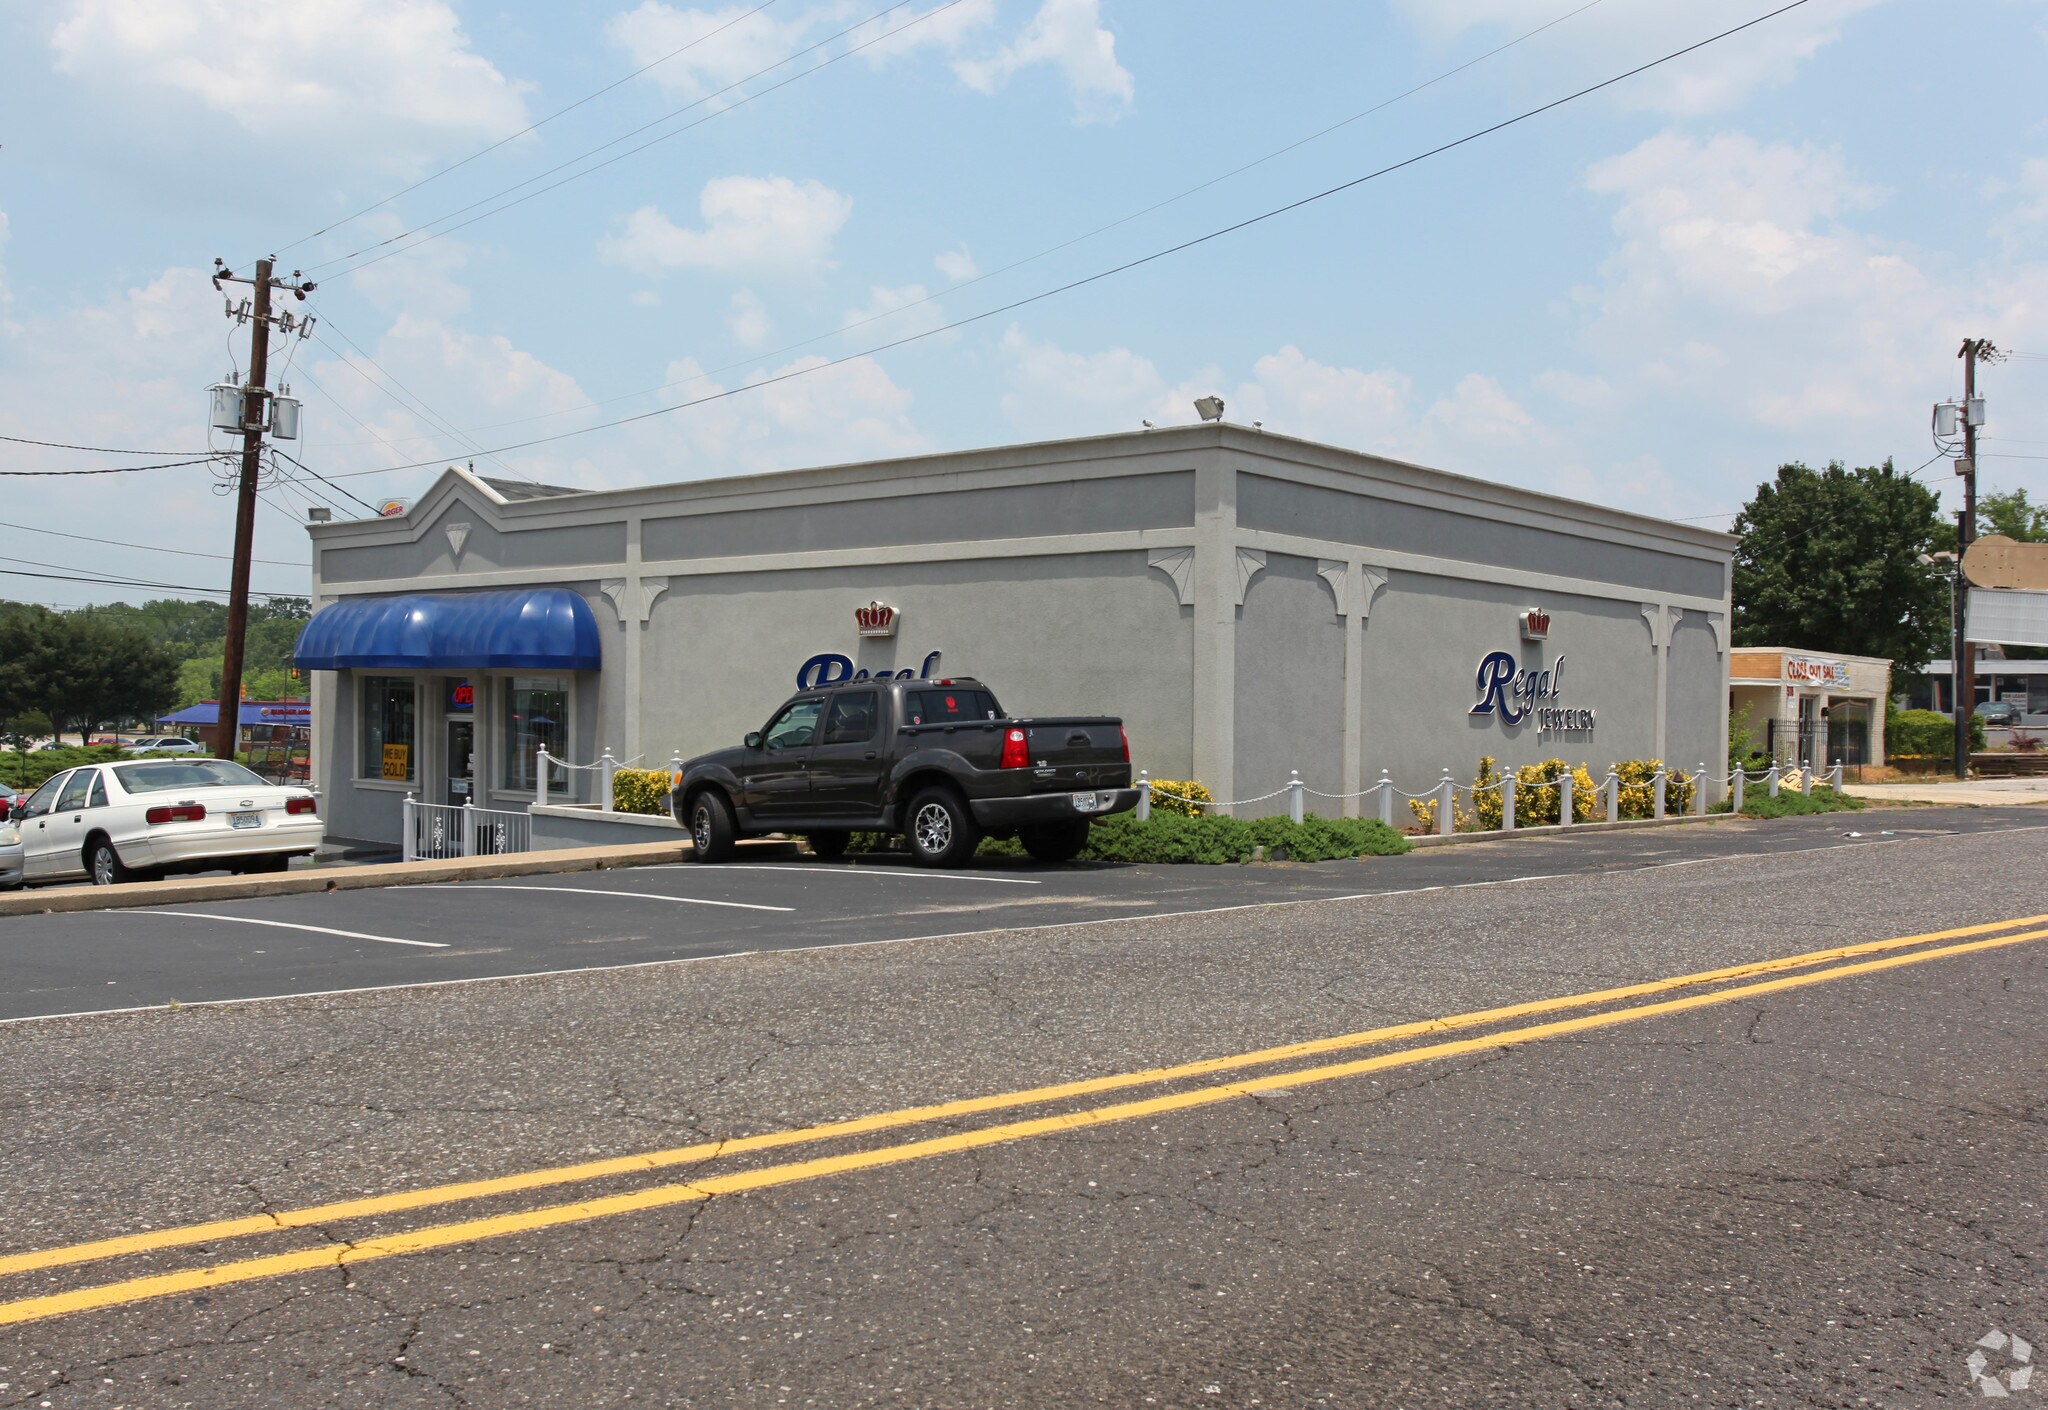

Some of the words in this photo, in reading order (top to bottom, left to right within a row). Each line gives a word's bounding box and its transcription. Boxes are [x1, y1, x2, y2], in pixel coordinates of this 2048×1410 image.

[1787, 661, 1809, 680] CLOSE
[1809, 664, 1820, 677] OUT
[1823, 665, 1834, 679] SALE
[455, 686, 474, 703] OPE
[1468, 650, 1565, 726] Regal
[1537, 708, 1597, 734] JEWELRY
[384, 748, 393, 759] WE
[394, 749, 406, 760] BUY
[383, 762, 406, 777] GOLD
